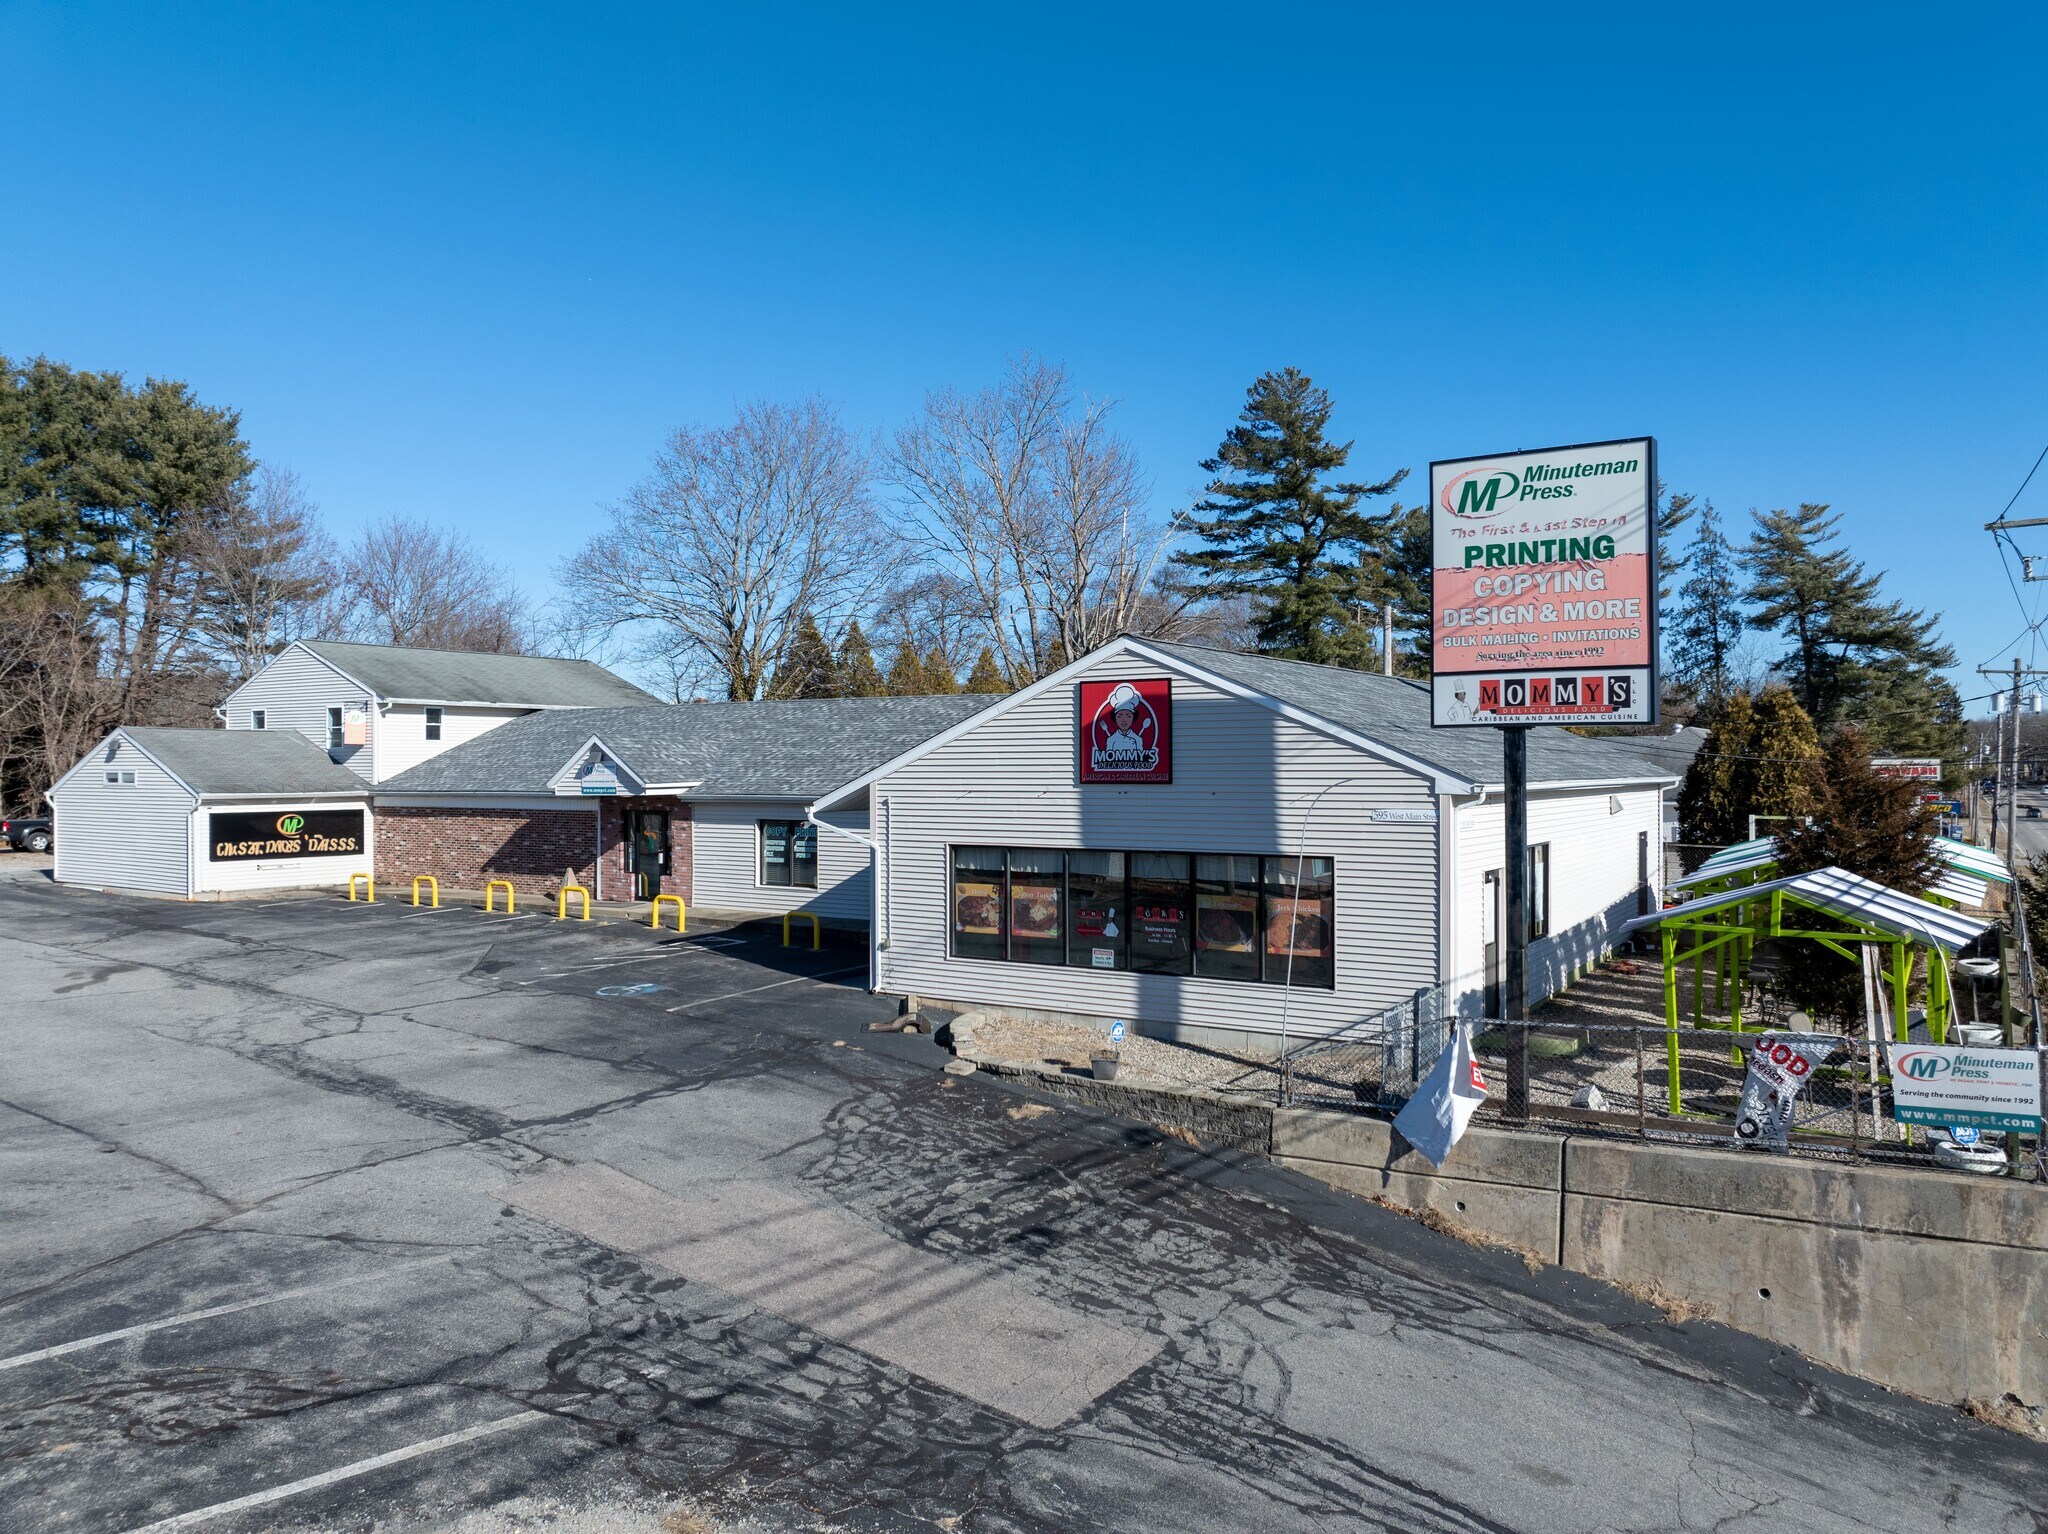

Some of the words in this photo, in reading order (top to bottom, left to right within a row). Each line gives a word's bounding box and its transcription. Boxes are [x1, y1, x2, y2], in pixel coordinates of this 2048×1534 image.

[1524, 459, 1638, 482] Minuteman
[1520, 484, 1574, 501] Press
[1482, 524, 1514, 536] First
[1464, 535, 1615, 569] PRINTING
[1474, 569, 1605, 598] COPYING
[1443, 605, 1534, 628] DESIGN
[1539, 602, 1559, 622] &
[1563, 598, 1640, 621] MORE
[1443, 635, 1478, 647] BULK
[1481, 632, 1539, 646] MAILING
[1552, 628, 1640, 643] INVITATIONS
[1476, 650, 1515, 661] Serving
[1513, 650, 1529, 659] the
[1532, 650, 1553, 658] area
[1555, 648, 1580, 657] since
[1583, 647, 1605, 656] 1992
[1481, 677, 1628, 706] MOMMY'S
[1502, 706, 1567, 714] DELICIOUS
[1574, 705, 1606, 713] FOOD
[1095, 750, 1156, 762] MOMMY'S
[1098, 761, 1132, 769] DELICIOUS
[1134, 761, 1153, 769] FOOD
[1374, 810, 1387, 819] 595
[766, 827, 787, 836] COPY
[1276, 904, 1290, 913] Jerk
[1954, 1056, 2034, 1070] Minuteman
[1952, 1067, 1989, 1078] Press
[1900, 1089, 1929, 1098] Serving
[1945, 1093, 1989, 1102] community
[1901, 1110, 2035, 1127] www.mmpct.com
